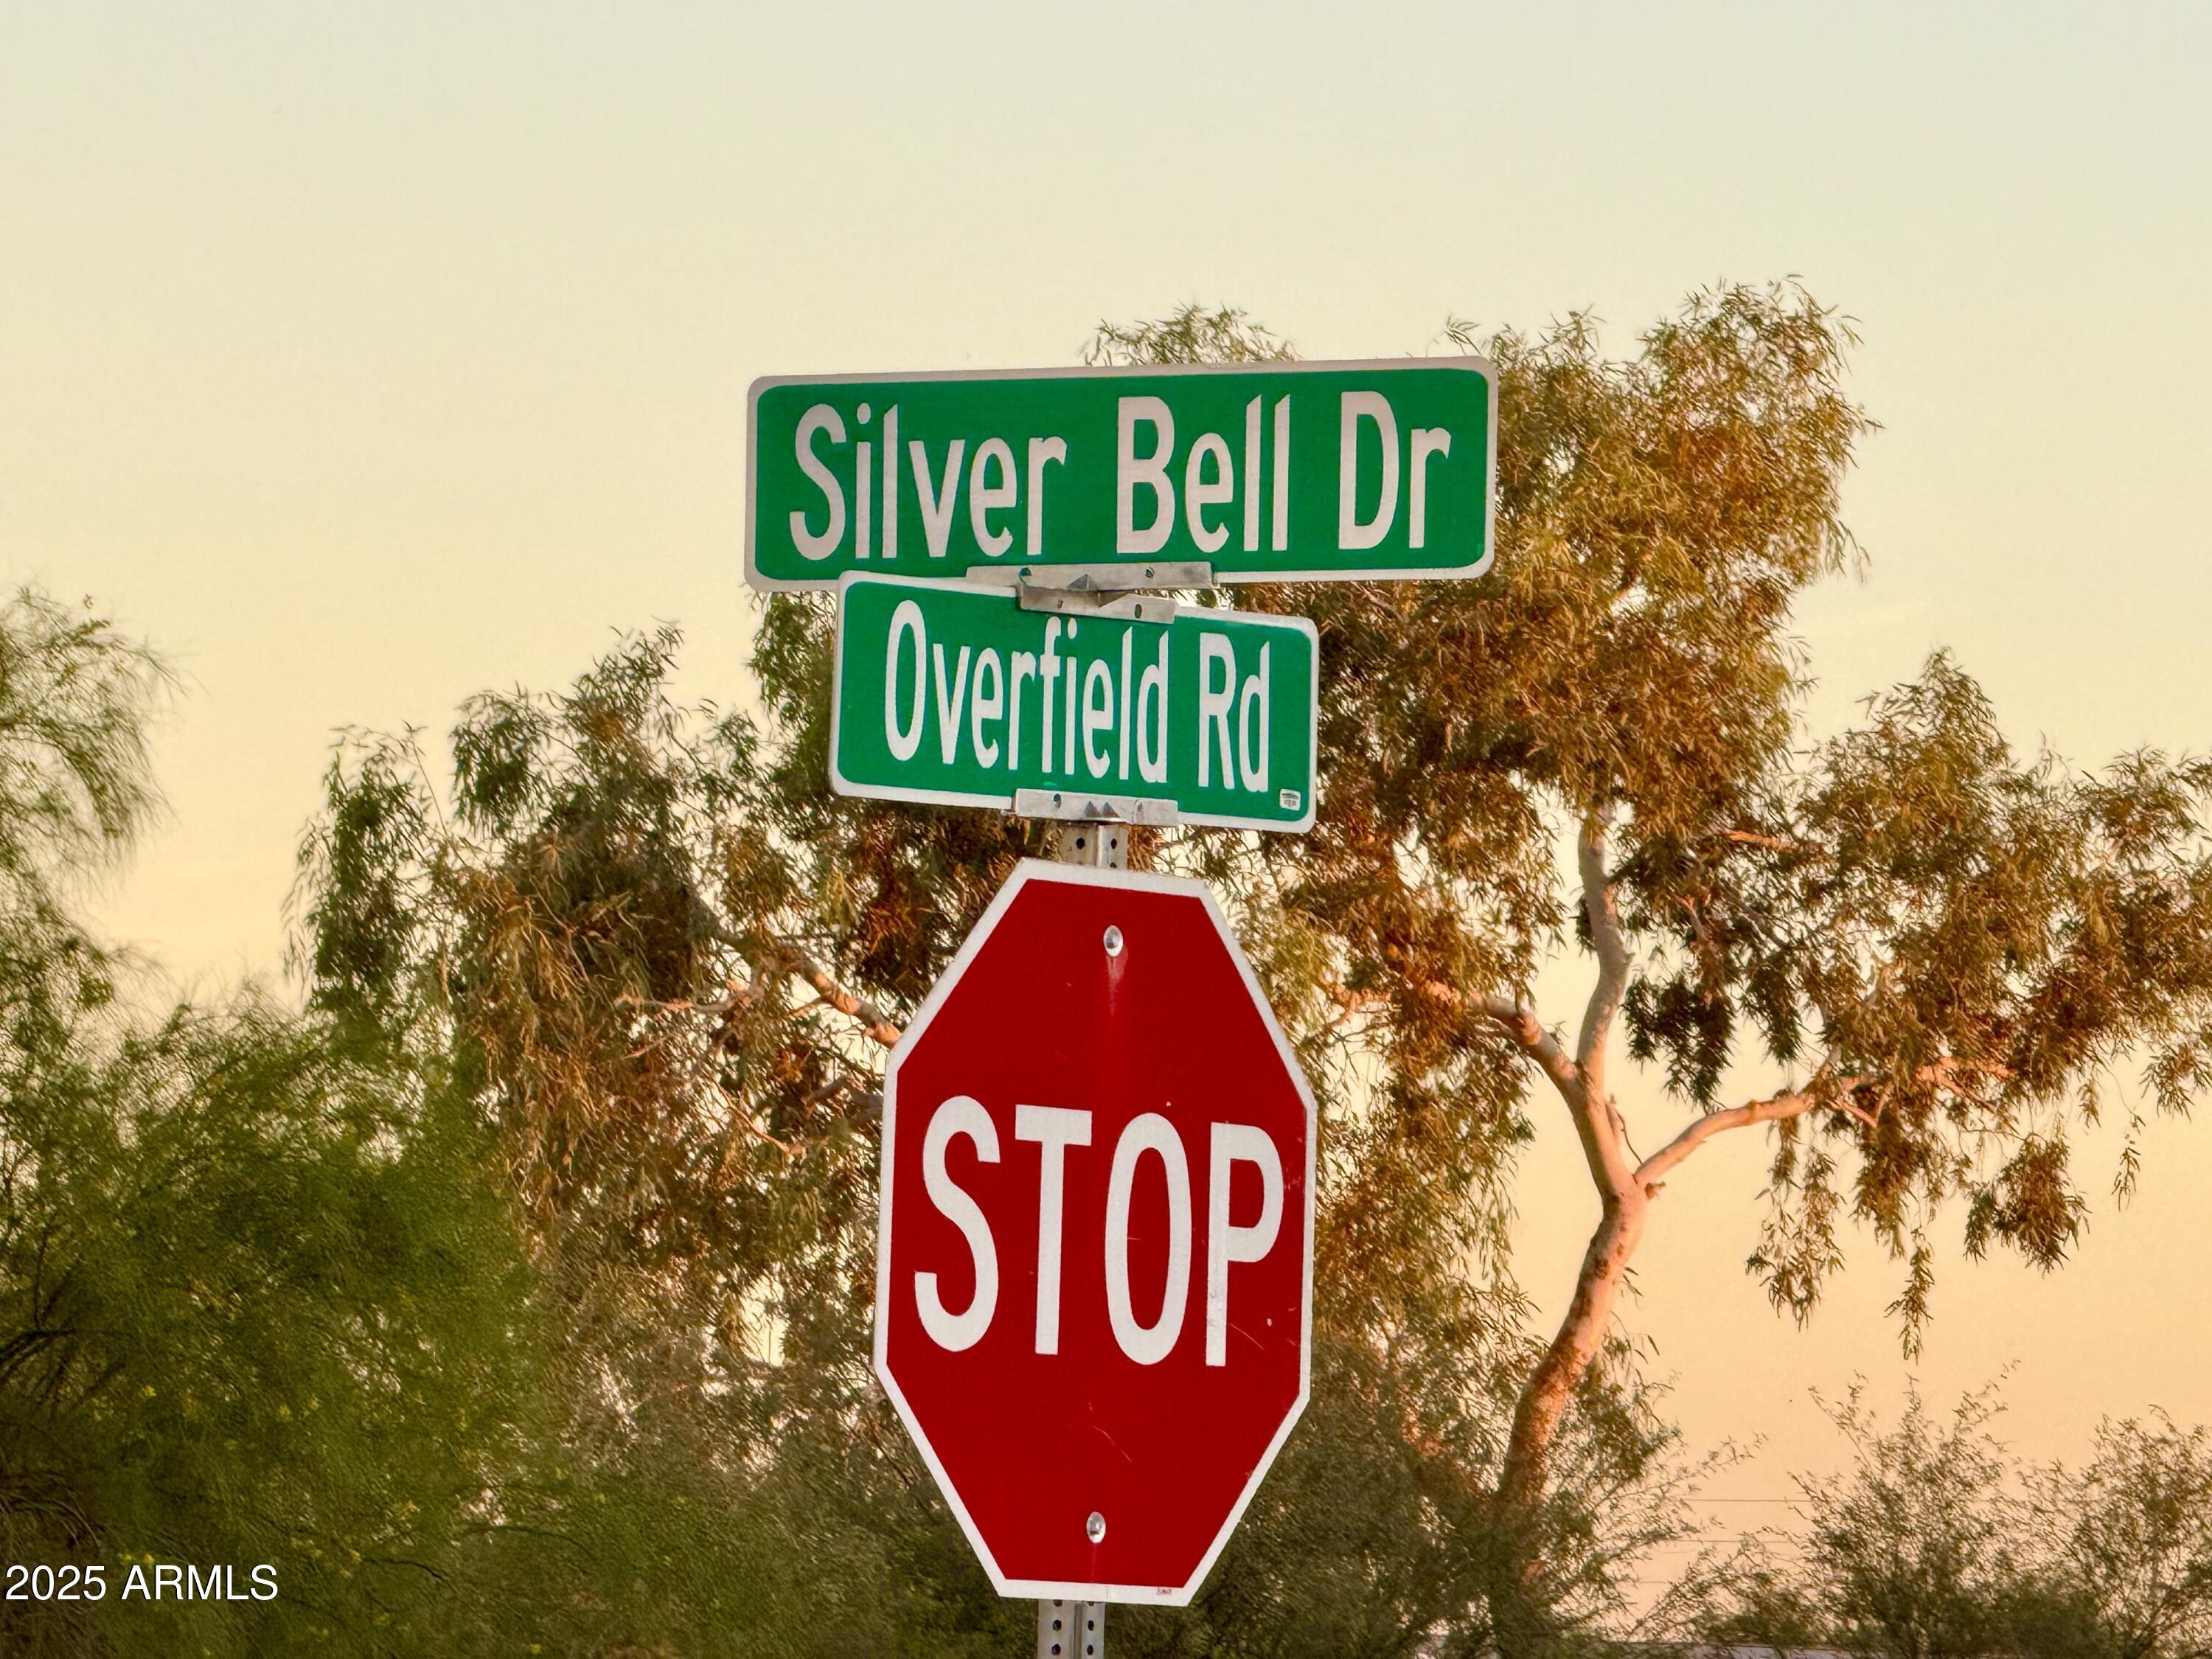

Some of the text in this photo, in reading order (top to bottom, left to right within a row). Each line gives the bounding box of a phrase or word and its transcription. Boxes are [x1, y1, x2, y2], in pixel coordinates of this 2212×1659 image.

[789, 390, 1452, 561] Silver Bell Dr
[885, 599, 1270, 793] Overfield Rd
[914, 1095, 1284, 1366] STOP
